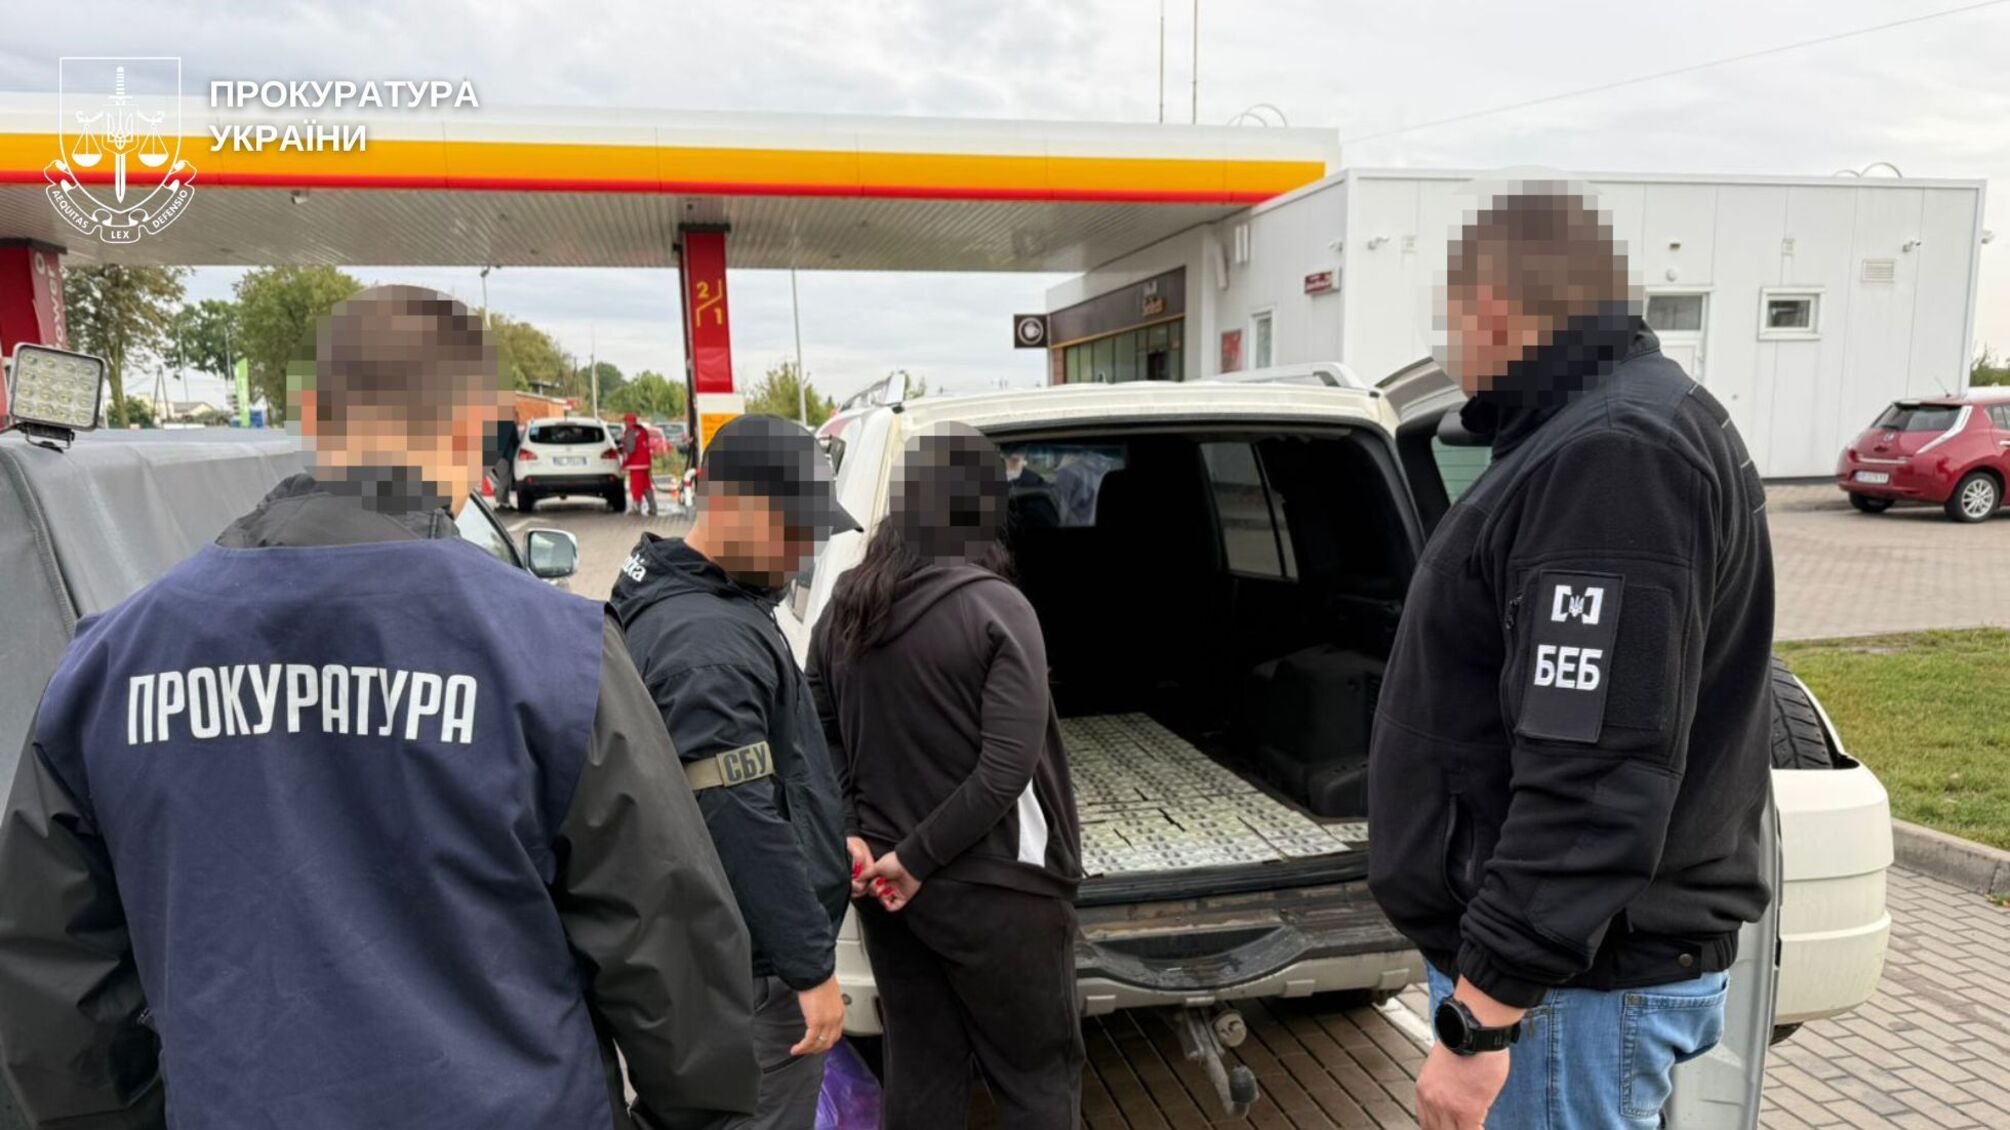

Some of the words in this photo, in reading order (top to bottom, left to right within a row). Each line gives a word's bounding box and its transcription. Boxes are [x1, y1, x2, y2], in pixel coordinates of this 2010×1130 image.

[696, 281, 710, 298] 2
[714, 307, 723, 325] 1
[1533, 644, 1603, 691] БЕБ
[127, 663, 478, 745] ПРОКУРАТУРА
[723, 743, 767, 782] СБУ
